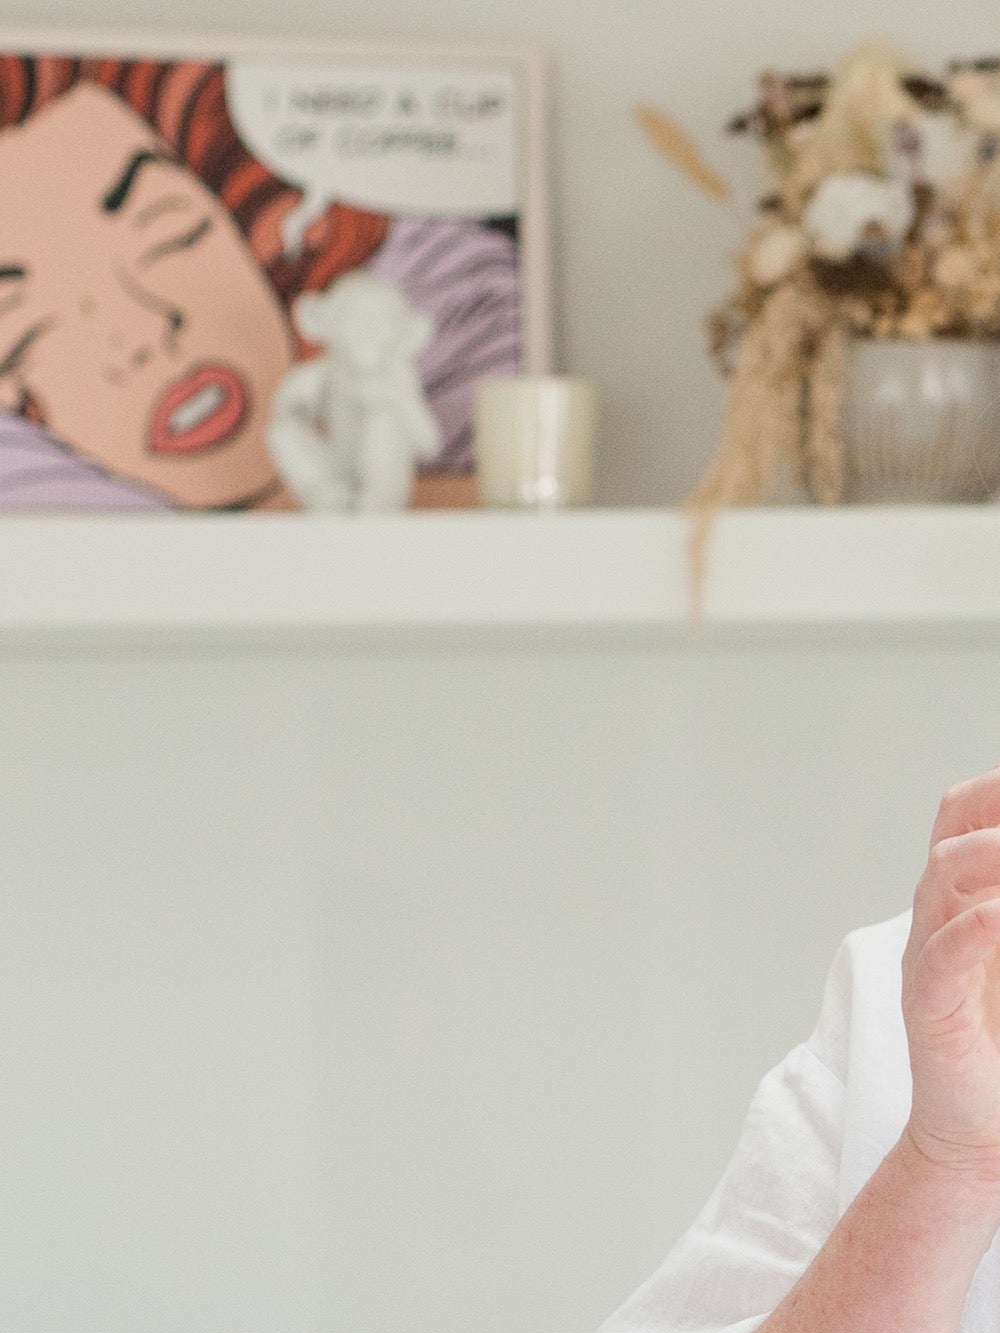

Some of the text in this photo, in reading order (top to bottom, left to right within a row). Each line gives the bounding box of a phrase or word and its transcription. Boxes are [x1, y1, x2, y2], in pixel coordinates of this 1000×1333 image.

[288, 84, 382, 117] NEED
[396, 86, 418, 115] A
[431, 83, 506, 118] CUP
[274, 125, 319, 155] OF
